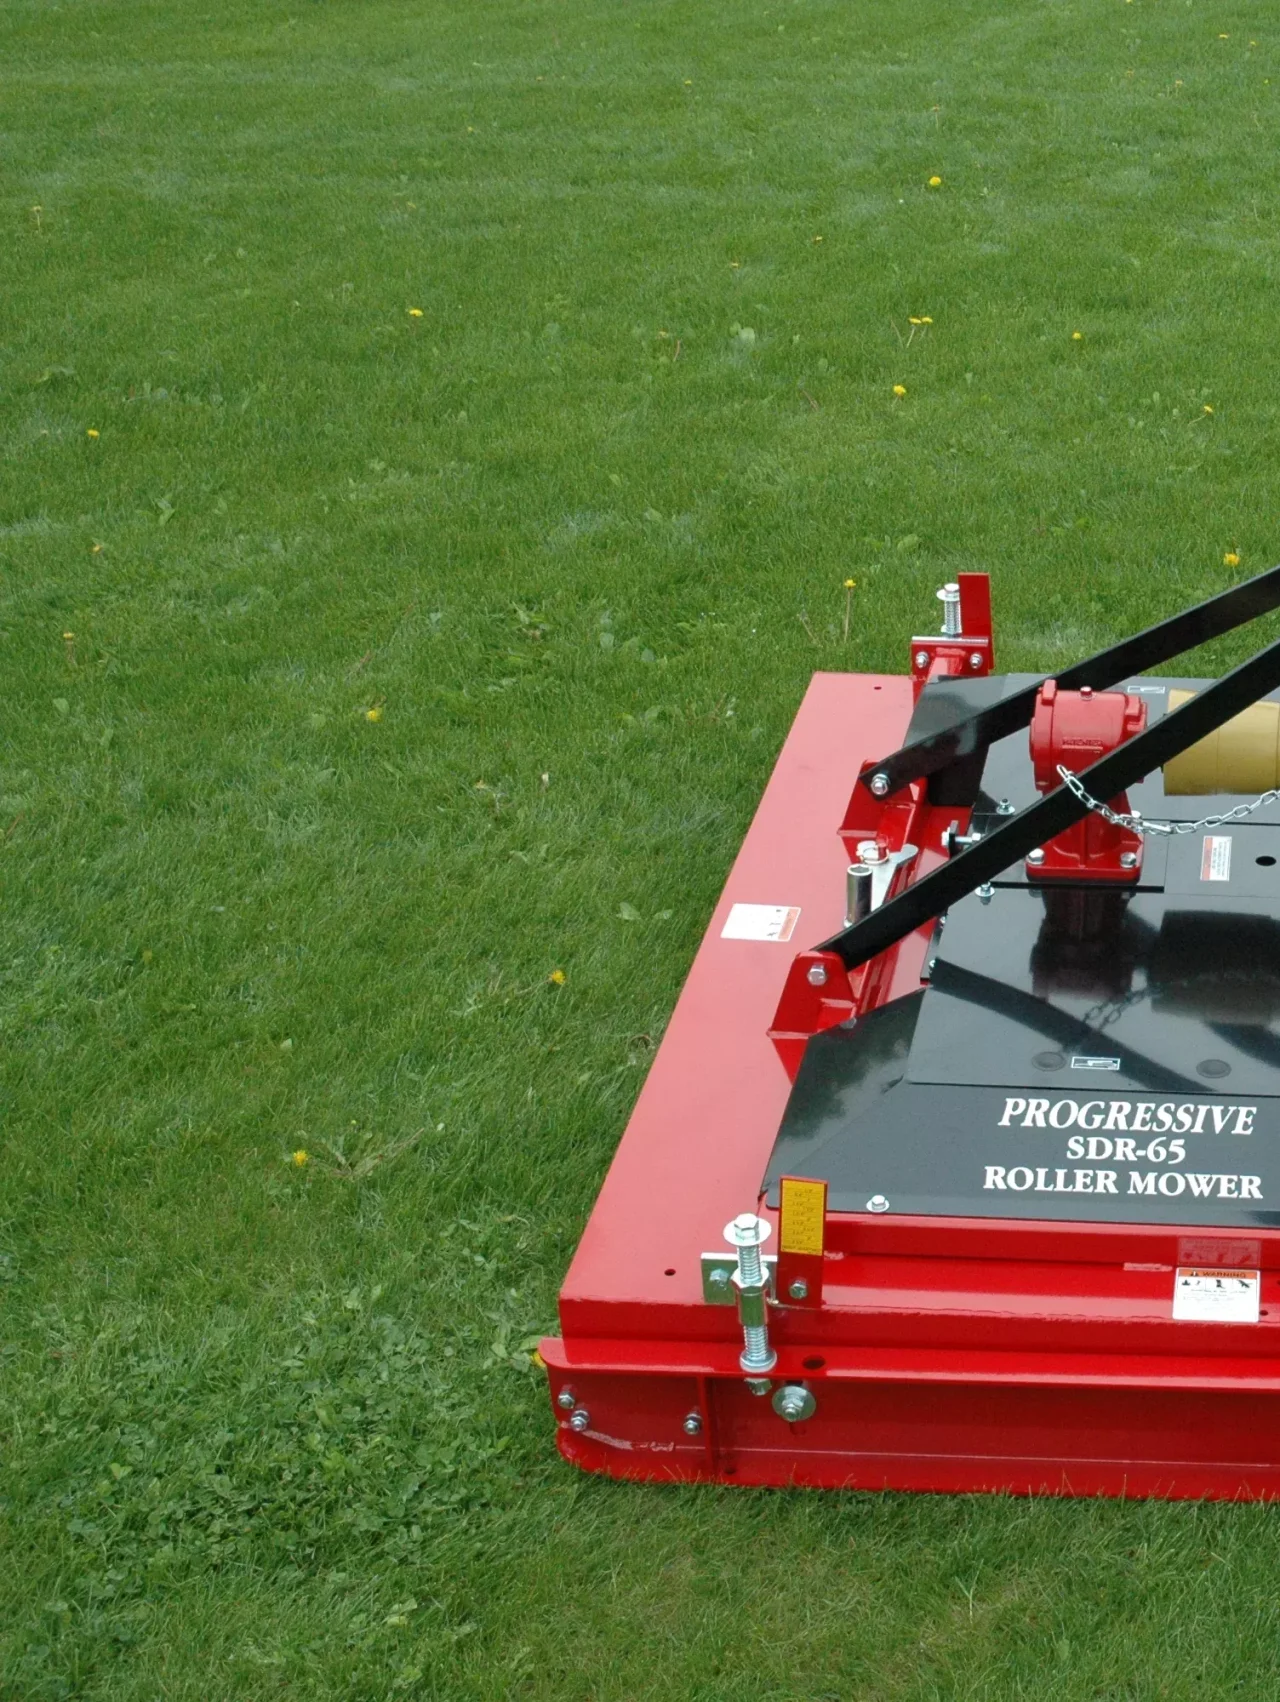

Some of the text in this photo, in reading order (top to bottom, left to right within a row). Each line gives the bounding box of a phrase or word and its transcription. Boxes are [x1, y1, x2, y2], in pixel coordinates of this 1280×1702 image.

[997, 1097, 1257, 1135] PROGRESSIVE
[1066, 1136, 1186, 1164] SDR-65
[983, 1166, 1264, 1199] ROLLER MOWER
[1202, 1270, 1247, 1279] WARNING
